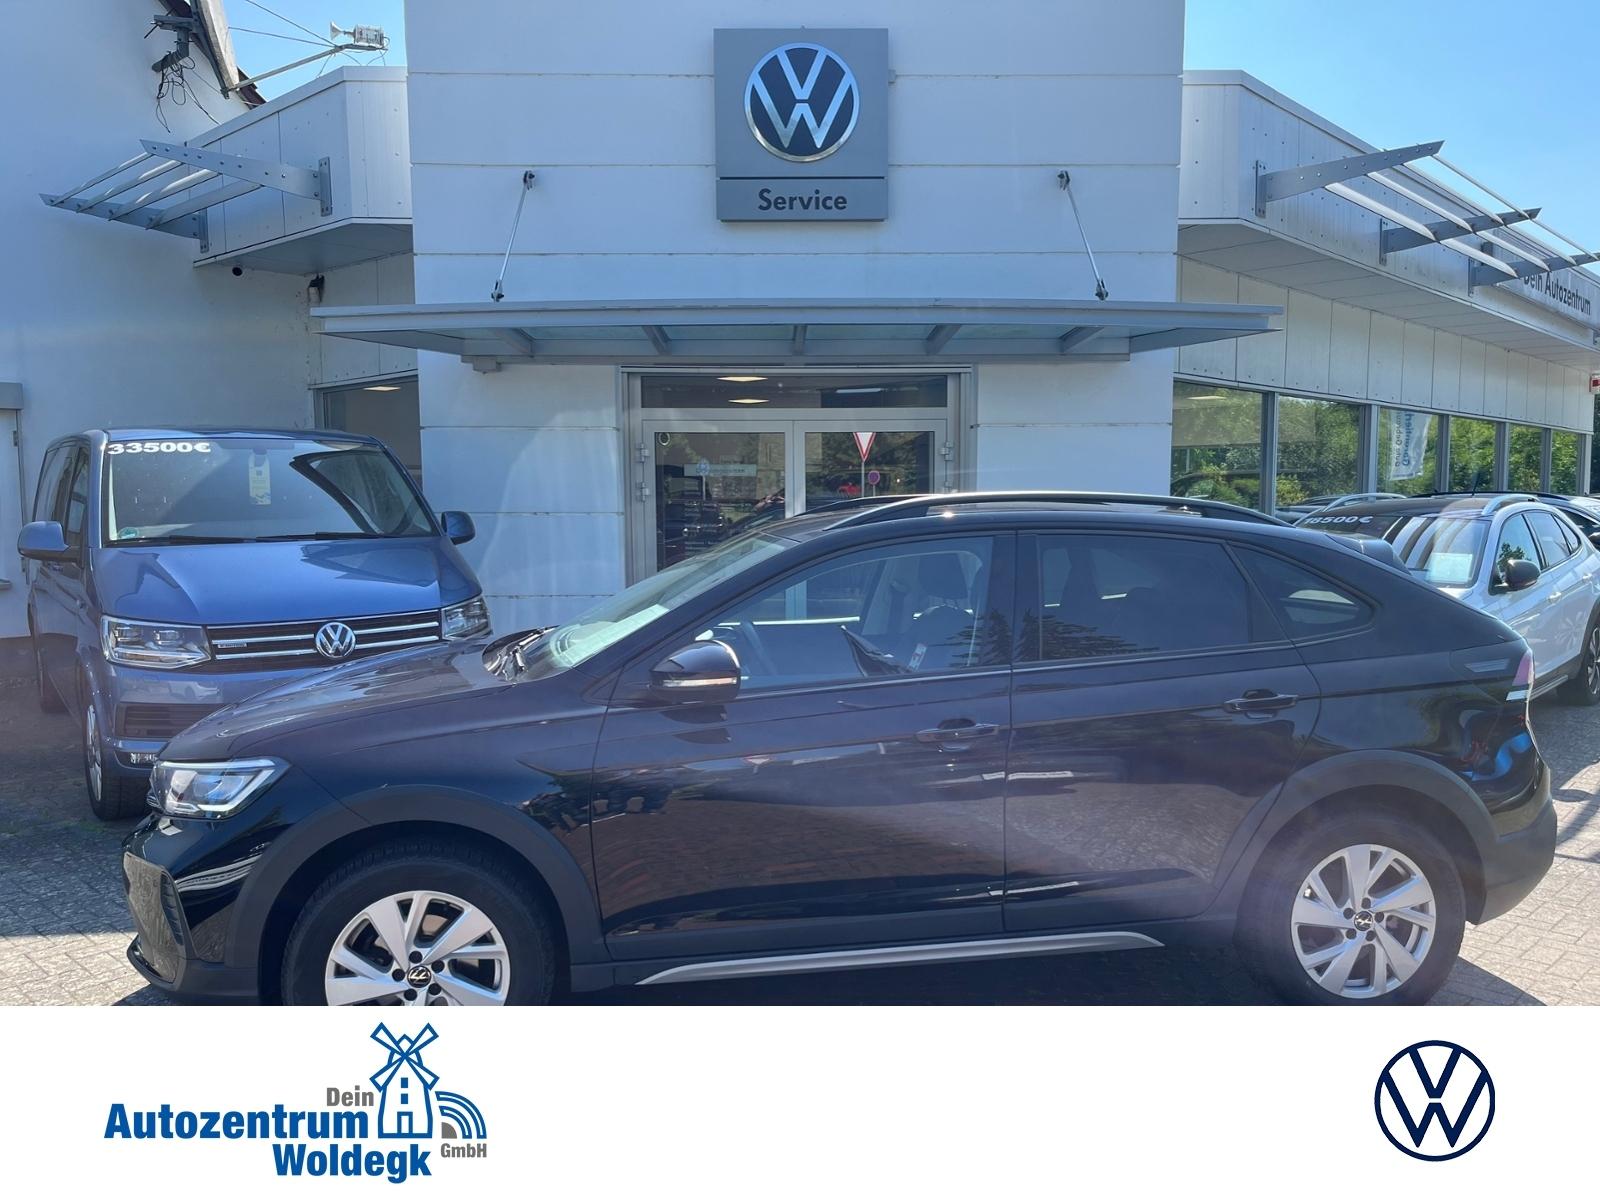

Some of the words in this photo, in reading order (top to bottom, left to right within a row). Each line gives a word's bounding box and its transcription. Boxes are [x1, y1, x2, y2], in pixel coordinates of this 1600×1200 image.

[758, 188, 847, 211] Service
[1545, 271, 1591, 316] Autozentrum
[107, 442, 212, 455] 33500€
